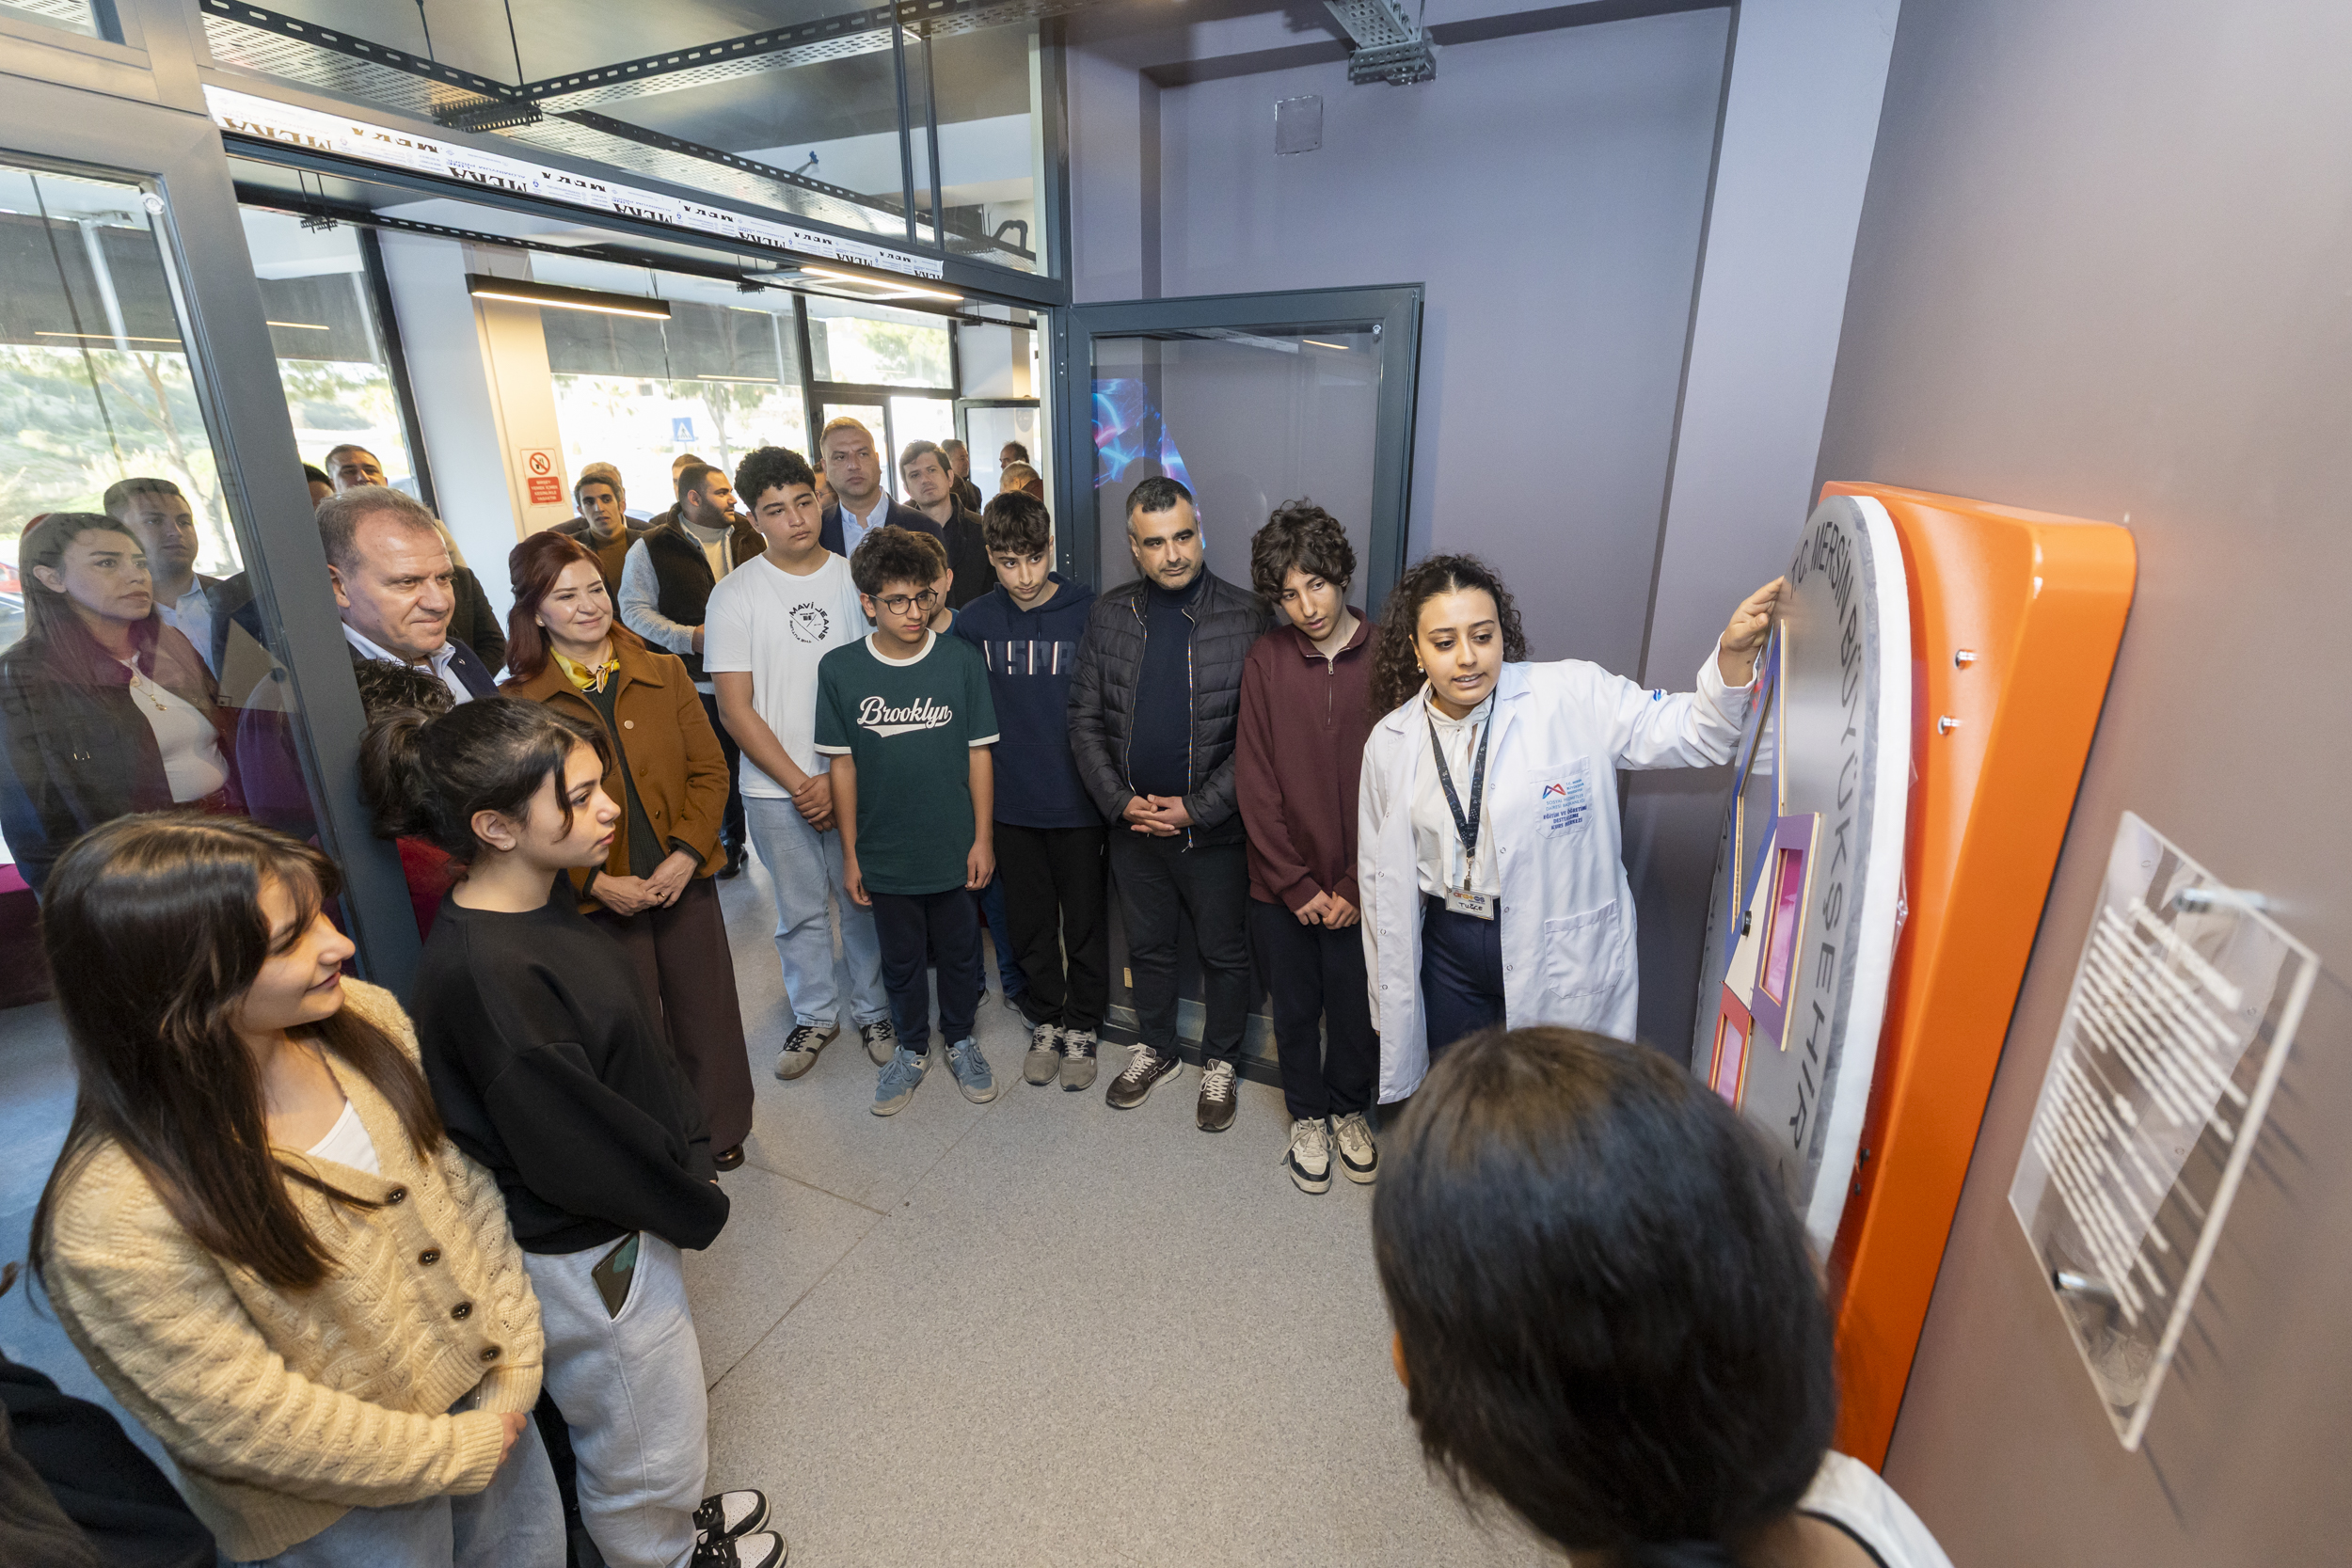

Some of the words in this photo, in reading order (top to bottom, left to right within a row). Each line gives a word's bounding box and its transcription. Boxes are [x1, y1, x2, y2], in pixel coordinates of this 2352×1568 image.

[352, 127, 438, 153] MEKA
[448, 166, 528, 192] MEKA
[541, 171, 607, 193] MEKA
[613, 202, 673, 224] MEKA
[684, 205, 734, 223] MEKA
[793, 231, 833, 245] MEKA
[880, 251, 912, 263] MEKA
[1810, 521, 1853, 626] MERSİN
[789, 601, 814, 616] MAVİ
[815, 608, 830, 640] JEANS
[856, 696, 953, 729] Brooklyn
[1789, 604, 1862, 1149] BÜYÜKŞEHİR
